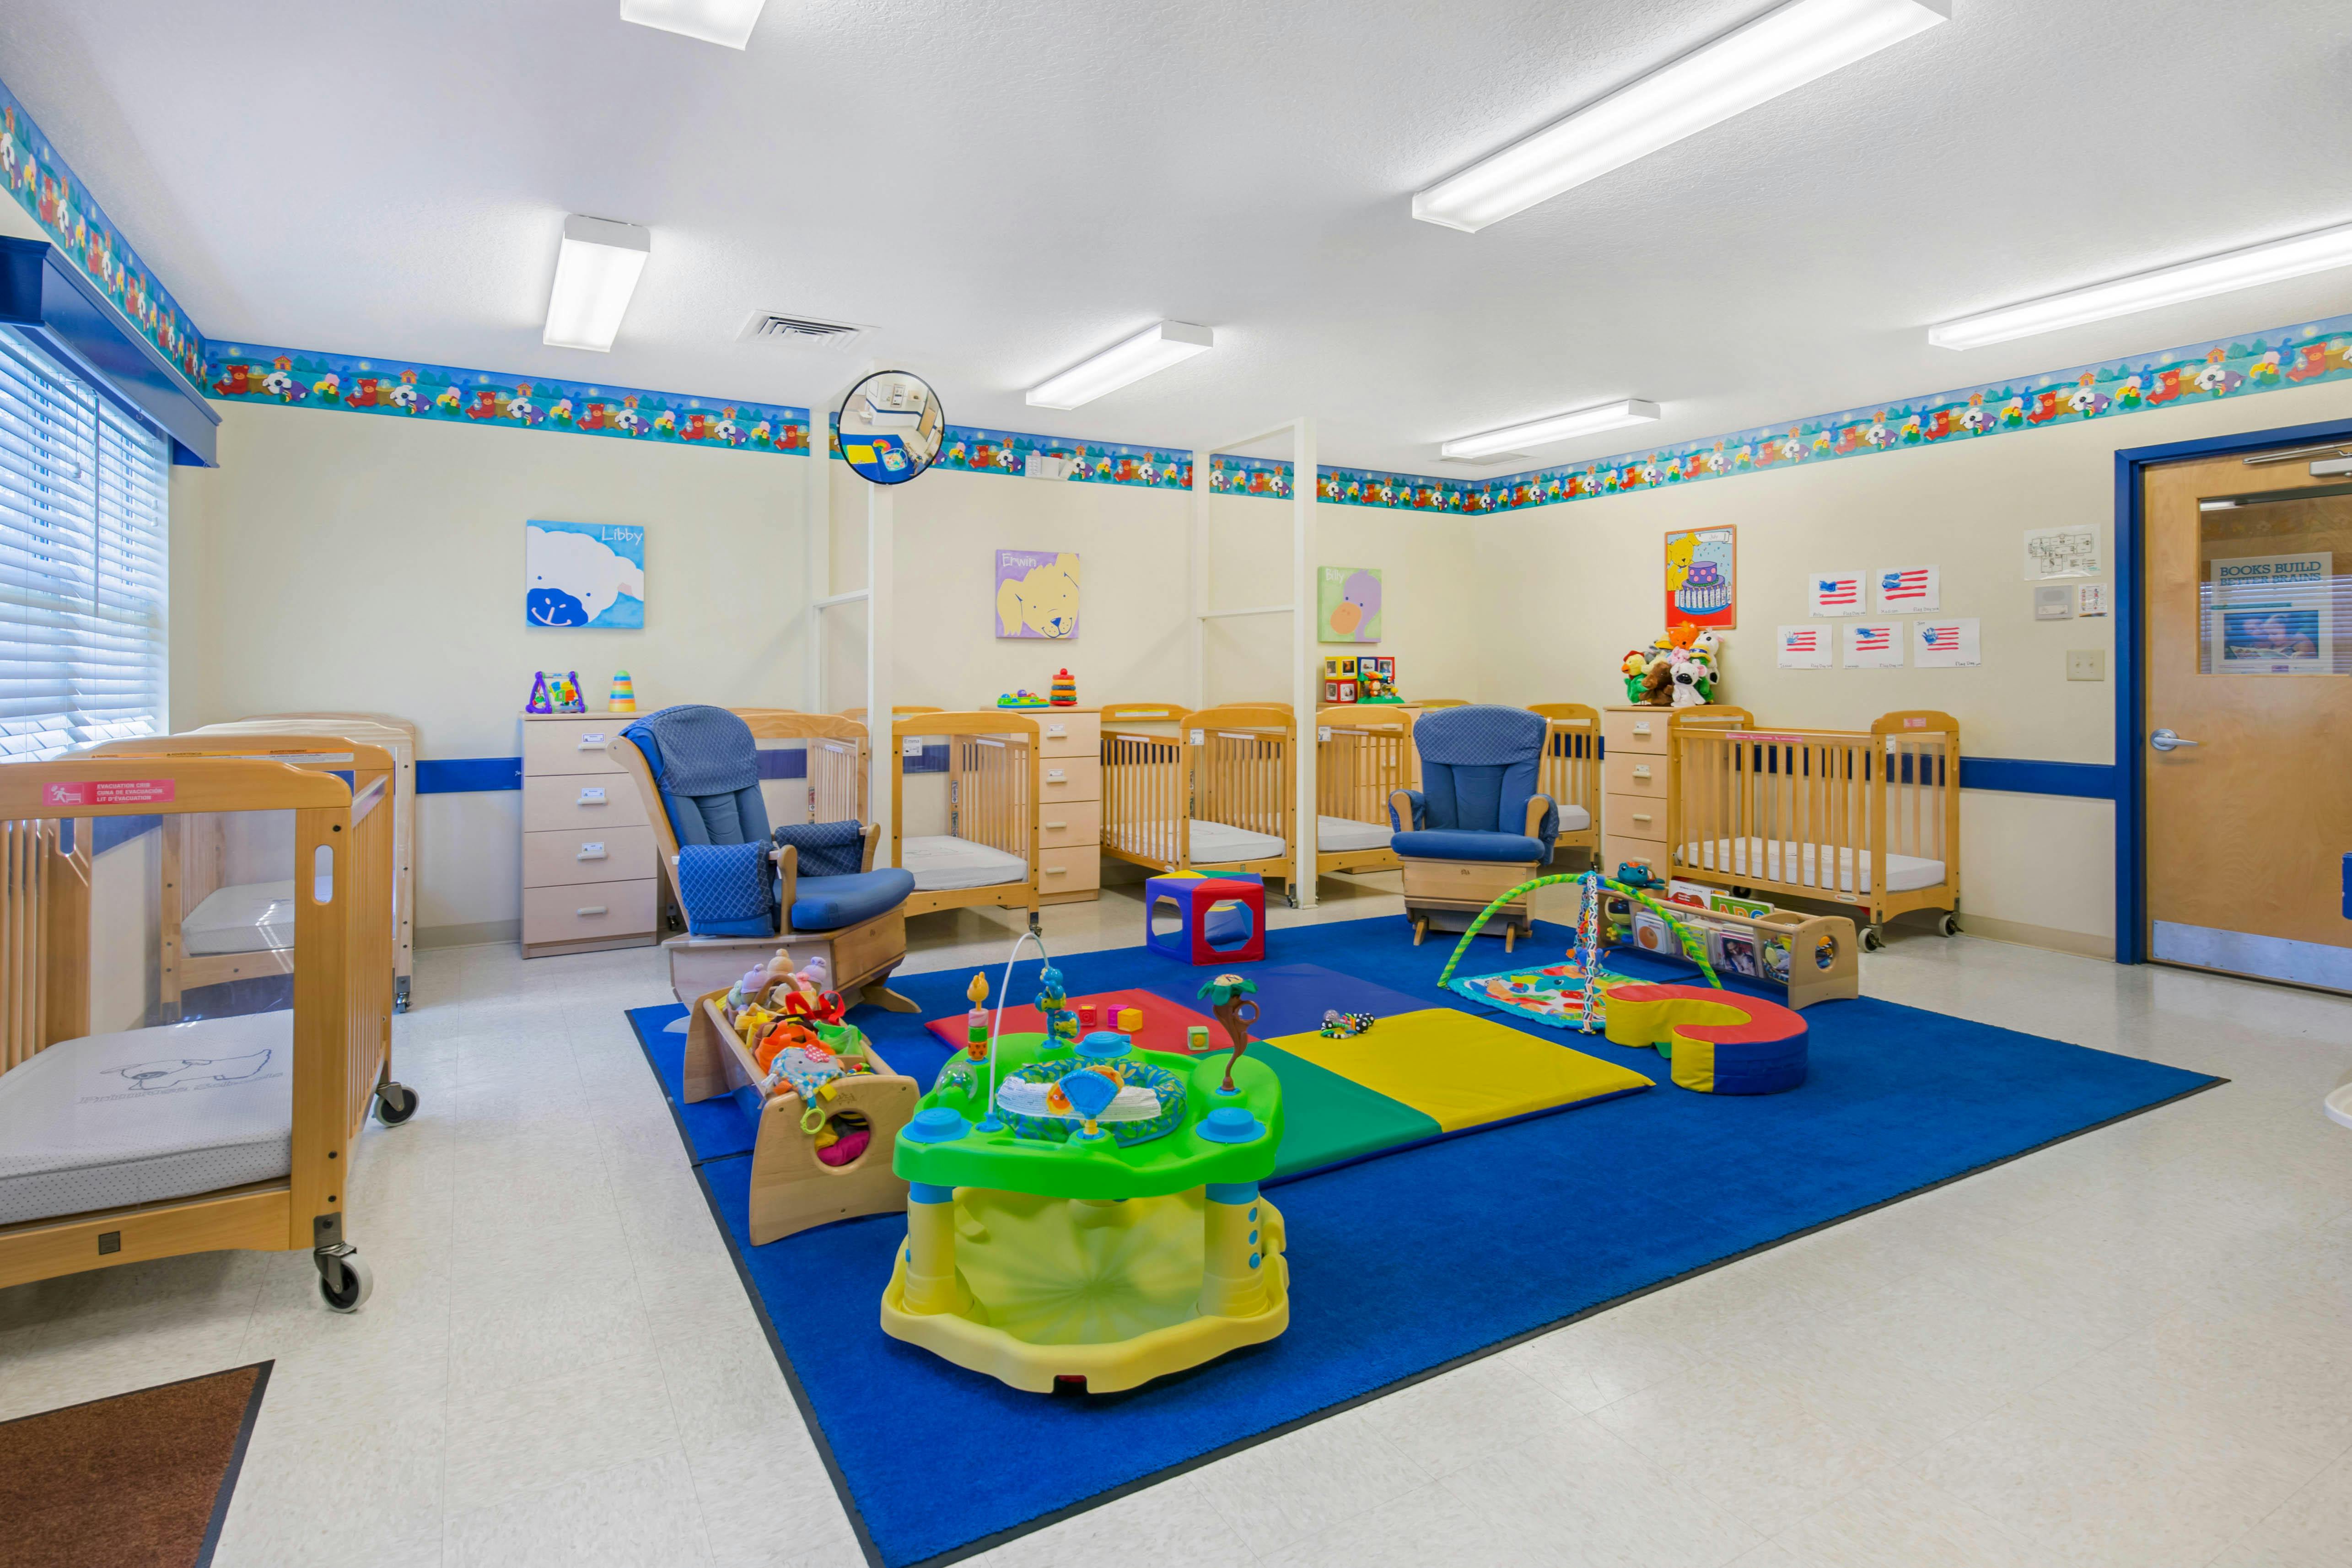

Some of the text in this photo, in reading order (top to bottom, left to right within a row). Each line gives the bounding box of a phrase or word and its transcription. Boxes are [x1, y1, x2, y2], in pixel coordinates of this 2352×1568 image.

[602, 526, 643, 546] Libby
[1002, 553, 1037, 567] Erwin
[1325, 568, 1344, 584] Billy
[2220, 561, 2321, 577] BOOKS BUILD
[2220, 572, 2321, 586] BETTER BRAINS
